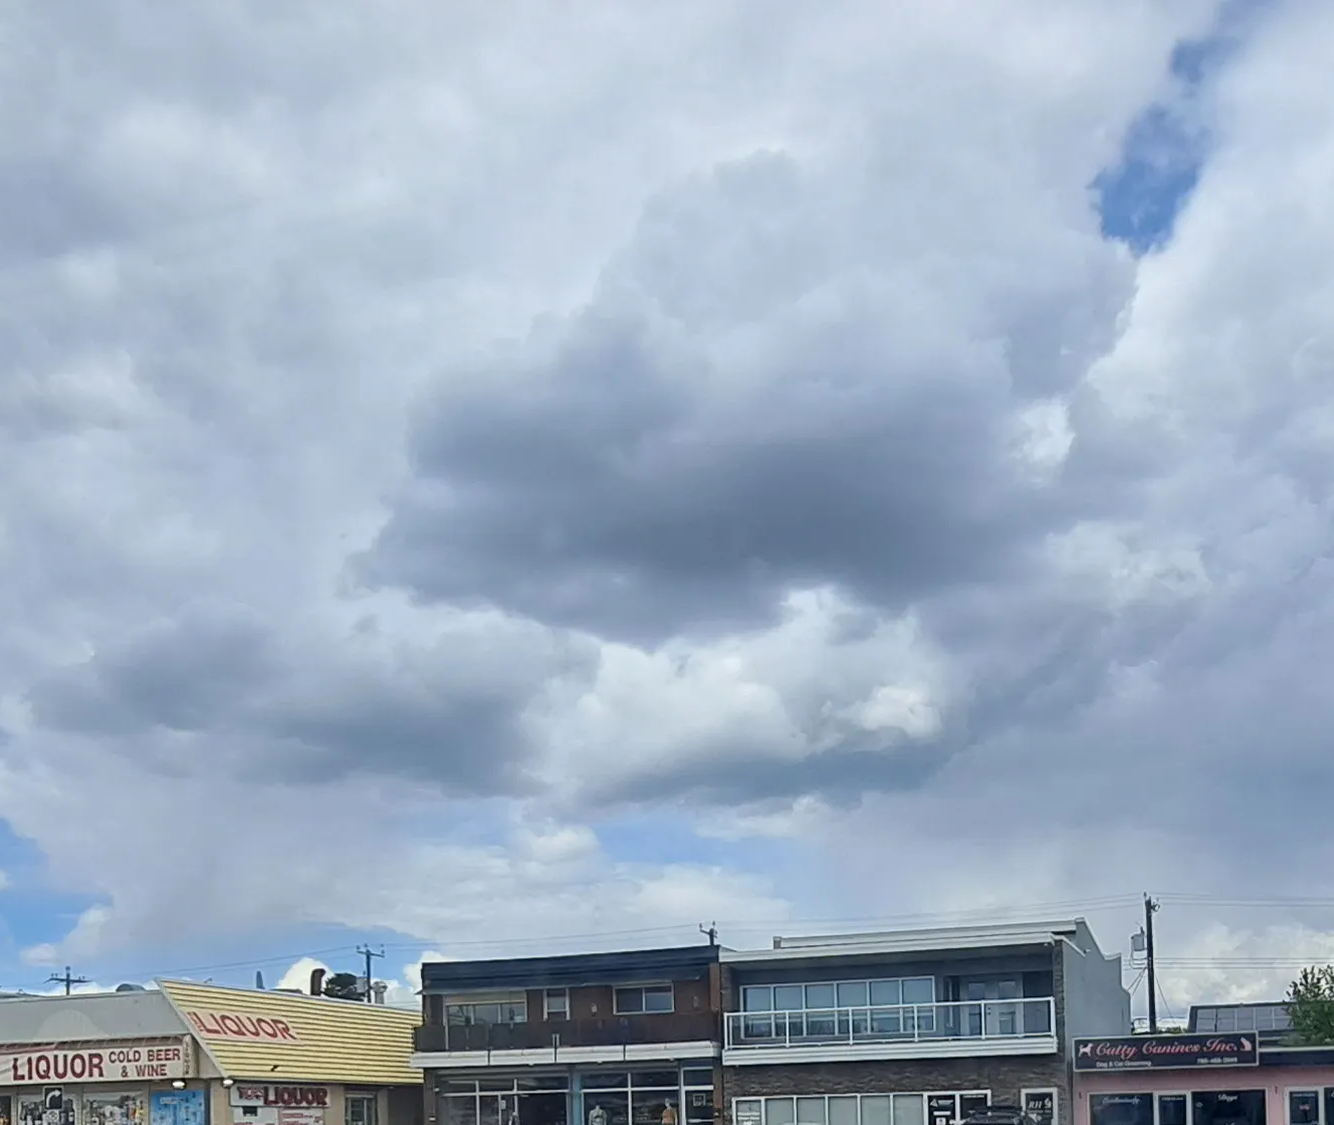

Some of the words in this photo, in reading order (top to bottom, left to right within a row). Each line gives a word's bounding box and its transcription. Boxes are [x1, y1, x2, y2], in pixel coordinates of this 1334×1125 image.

[192, 1011, 298, 1040] LIQUOR
[1142, 1039, 1201, 1054] Canines
[108, 1050, 142, 1063] COLD
[147, 1048, 181, 1062] BEER
[12, 1053, 105, 1081] LIQUOR
[120, 1065, 129, 1078] &
[135, 1063, 168, 1077] WINE
[264, 1086, 328, 1106] LIQUOR
